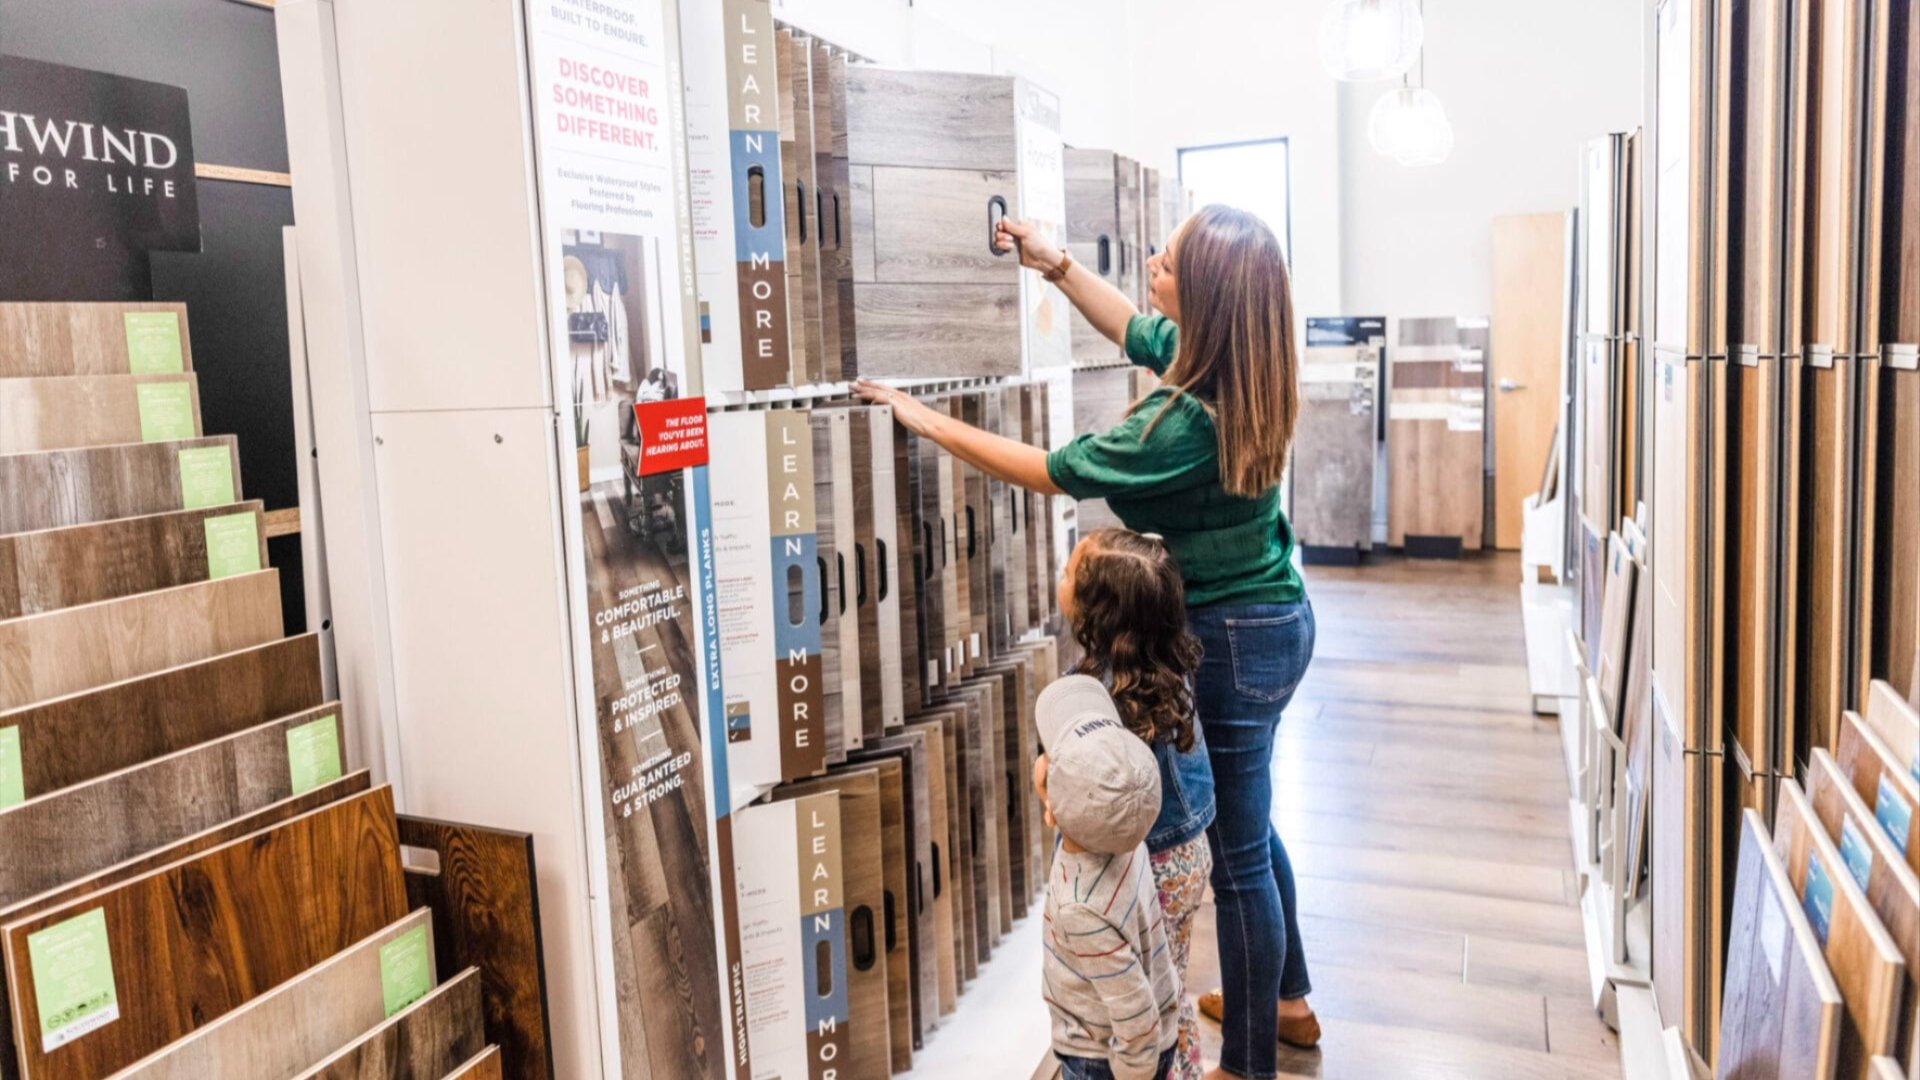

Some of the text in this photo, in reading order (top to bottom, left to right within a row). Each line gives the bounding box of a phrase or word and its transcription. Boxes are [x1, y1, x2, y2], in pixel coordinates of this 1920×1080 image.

[551, 5, 649, 48] BUILT TO ENDURE.
[562, 0, 639, 27] ATERPROOF.
[559, 57, 649, 99] DISCOVER
[741, 14, 763, 153] LEARN
[553, 83, 658, 126] SOMETHING
[557, 112, 659, 152] DIFFERENT.
[9, 163, 175, 198] FOR LIFE
[557, 167, 661, 193] Exclusive Waterproof Styles
[589, 187, 635, 203] Preferred by
[571, 199, 654, 218] Flooring Professionals
[751, 251, 774, 358] MORE
[665, 415, 703, 428] THE FLOOR
[686, 427, 704, 437] BEEN
[646, 443, 678, 456] HEARING
[782, 427, 801, 556] LEARN
[596, 585, 684, 626] COMFORTABLE
[619, 579, 660, 600] SOMETHING
[702, 528, 720, 690] EXTRA LONG PLANKS
[602, 605, 681, 644] & BEAUTIFUL.
[612, 674, 681, 715] PROTECTED
[626, 666, 667, 690] SOMETHING
[789, 648, 809, 748] MORE
[614, 692, 682, 733] & INSPIRED.
[612, 751, 692, 805] GUARANTEED
[632, 749, 672, 776] SOMETHING
[623, 774, 685, 818] & STRONG.
[812, 811, 831, 934] LEARN
[733, 962, 747, 1067] HIGH-TRAFFIC
